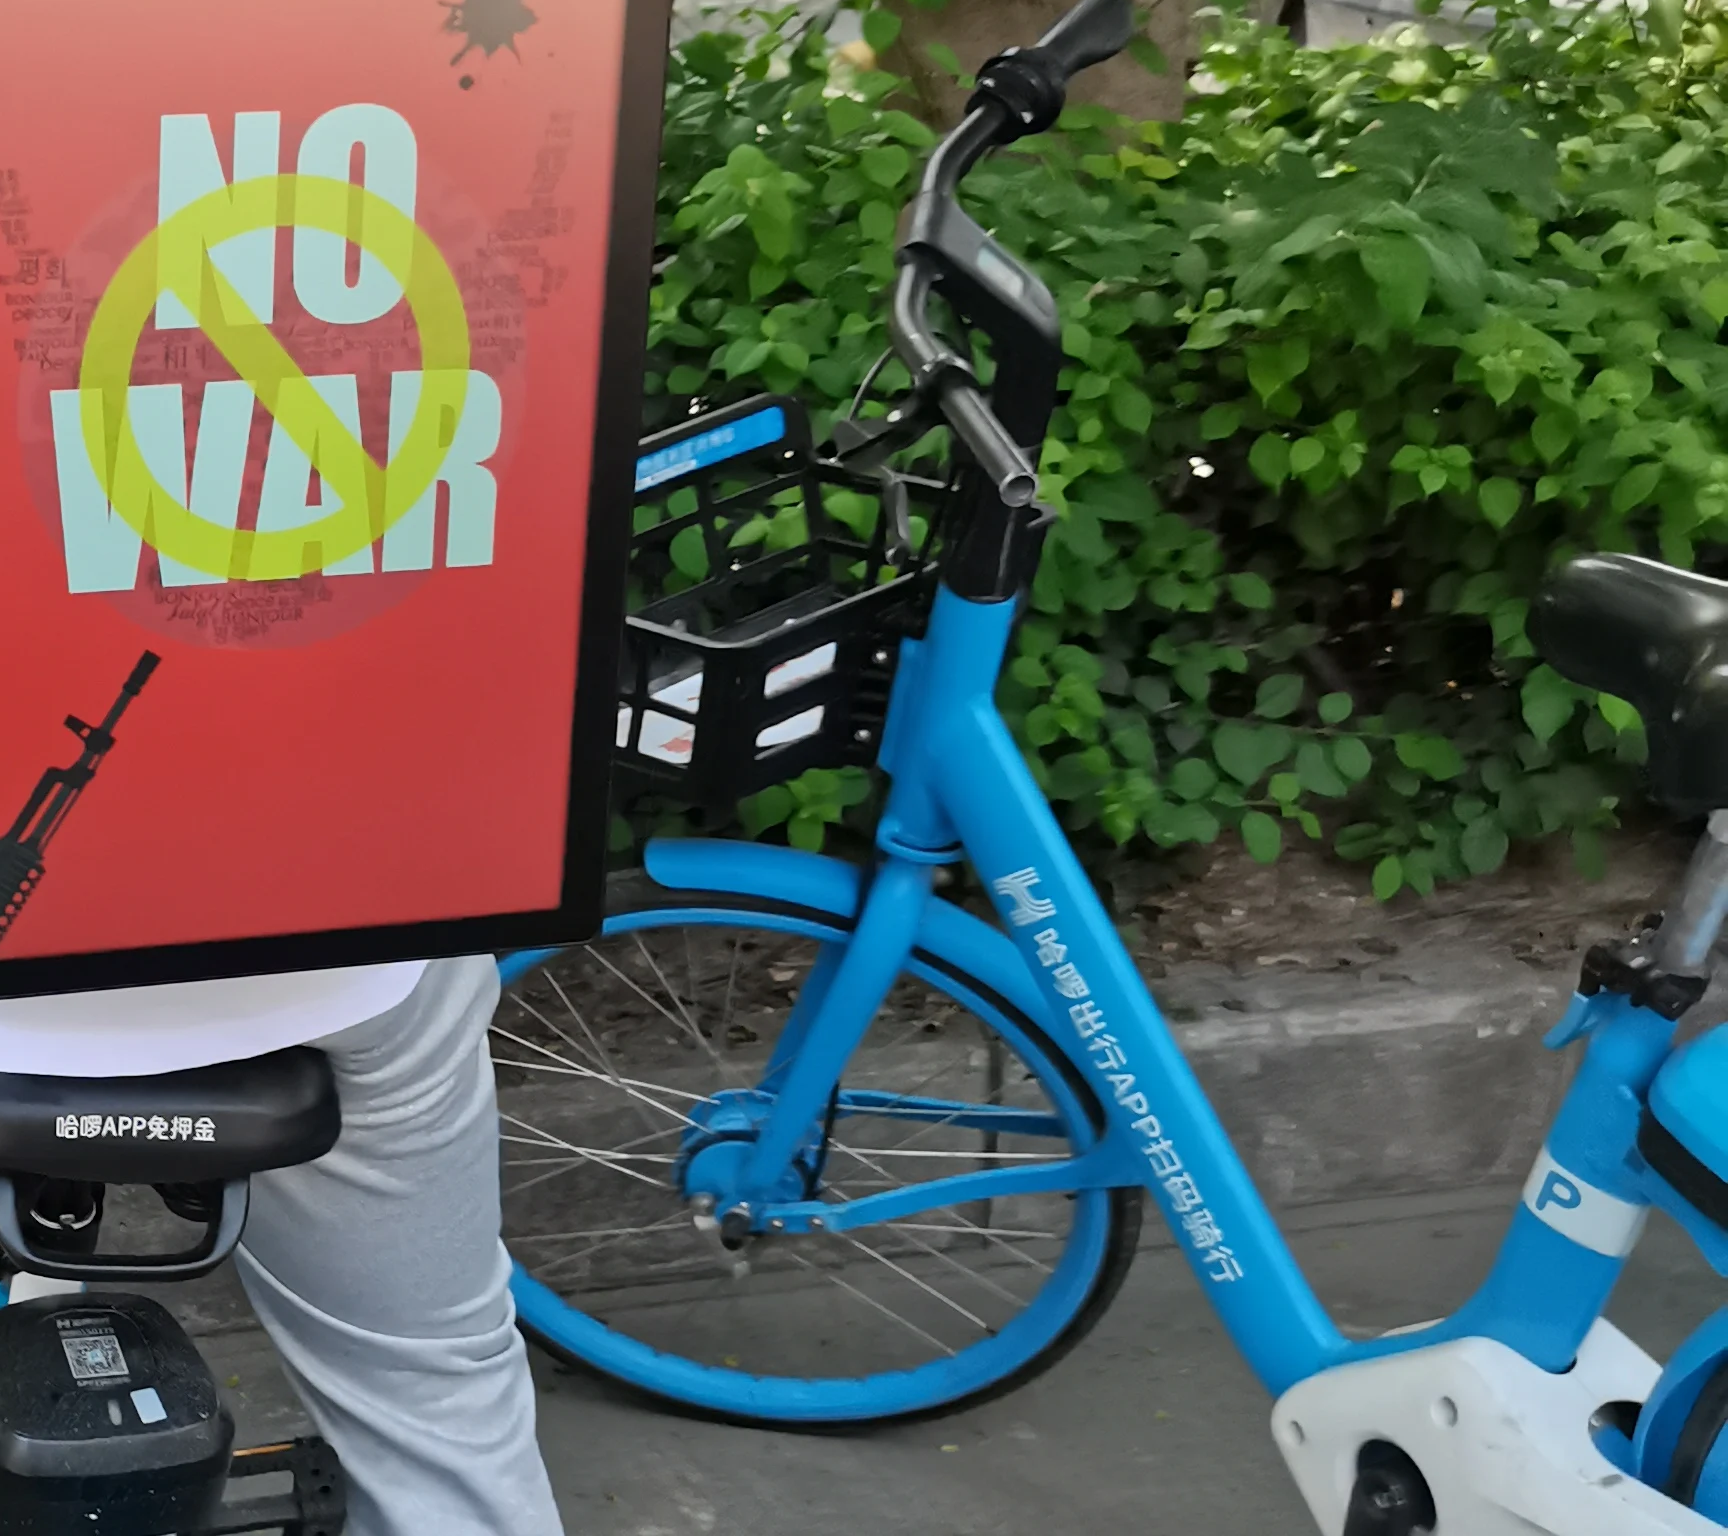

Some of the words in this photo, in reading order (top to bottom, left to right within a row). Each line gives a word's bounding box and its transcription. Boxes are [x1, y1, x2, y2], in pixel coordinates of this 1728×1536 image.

[156, 103, 418, 331] NO
[50, 368, 502, 594] WAR
[55, 1114, 217, 1142] 哈啰APP免押金
[1032, 927, 1244, 1283] 哈啰出行APP扫码骑行
[1534, 1170, 1582, 1212] P
